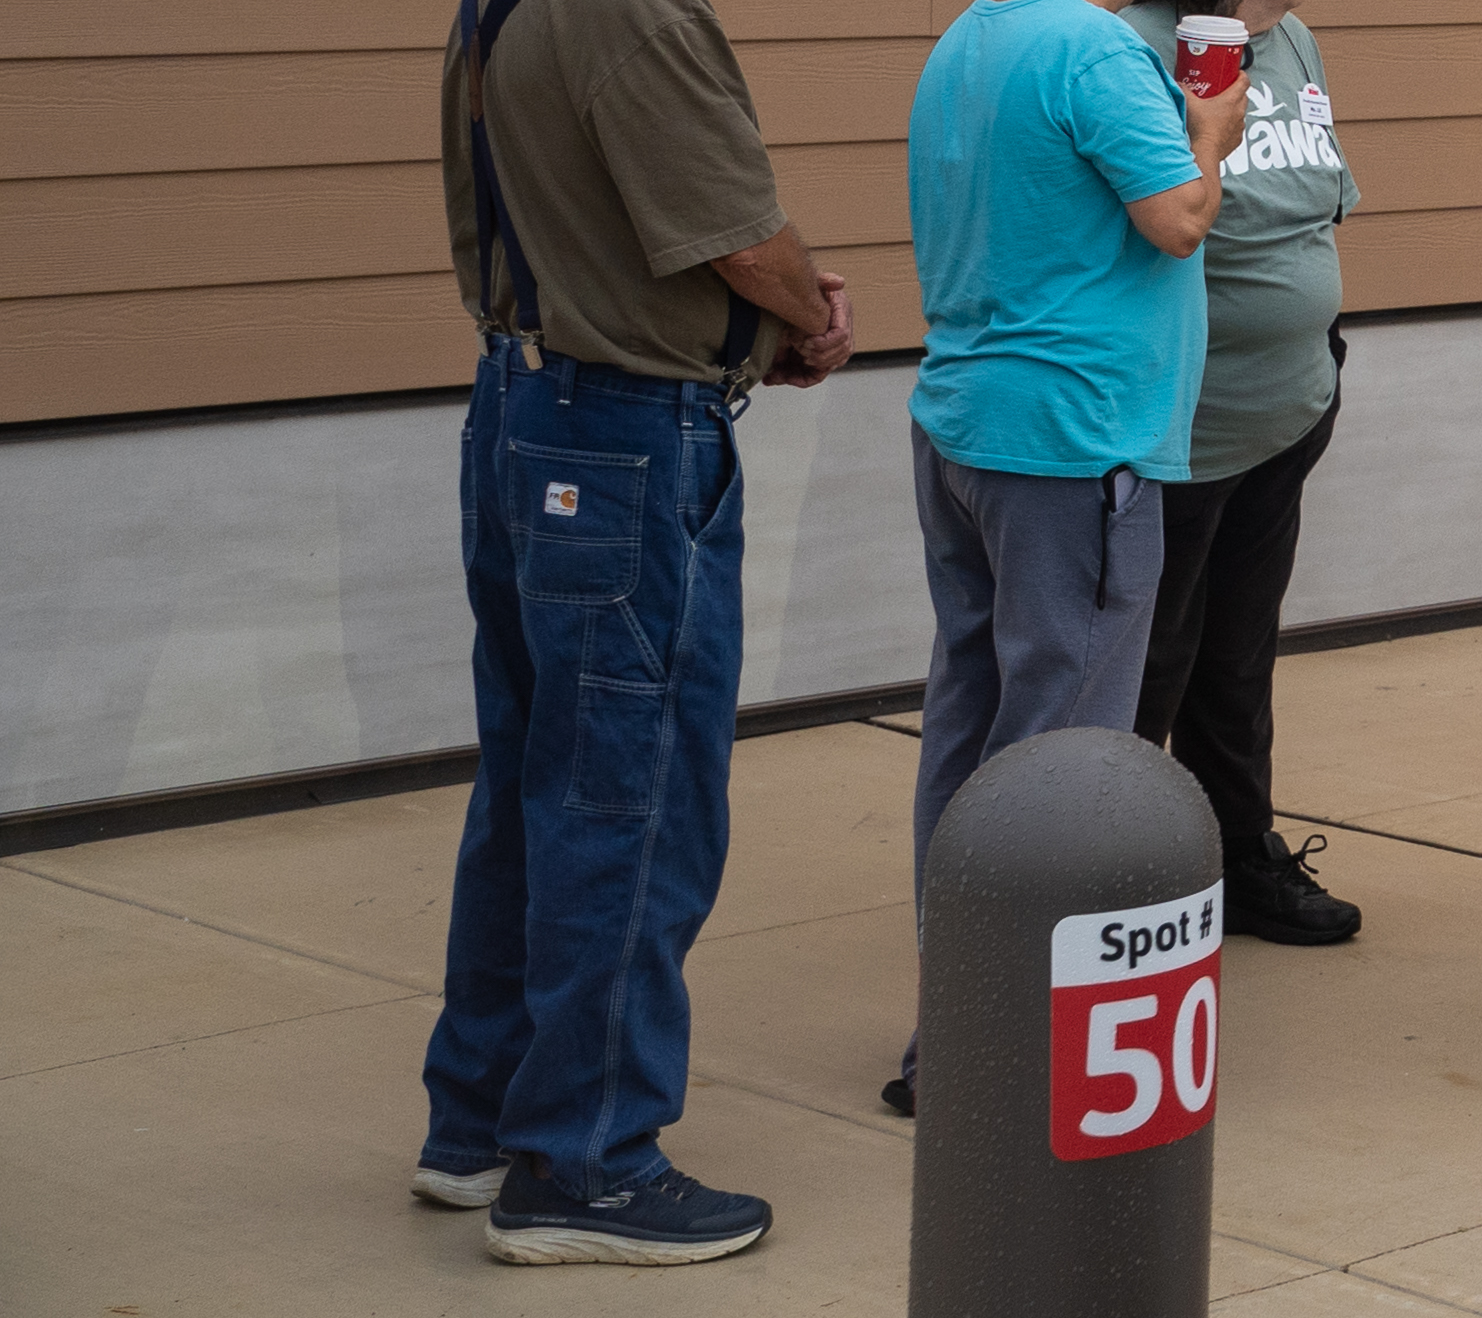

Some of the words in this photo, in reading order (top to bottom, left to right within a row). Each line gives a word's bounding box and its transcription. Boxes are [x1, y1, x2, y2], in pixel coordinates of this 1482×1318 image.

[1100, 910, 1191, 969] Spot
[1199, 898, 1214, 941] #
[1079, 975, 1217, 1139] 50
